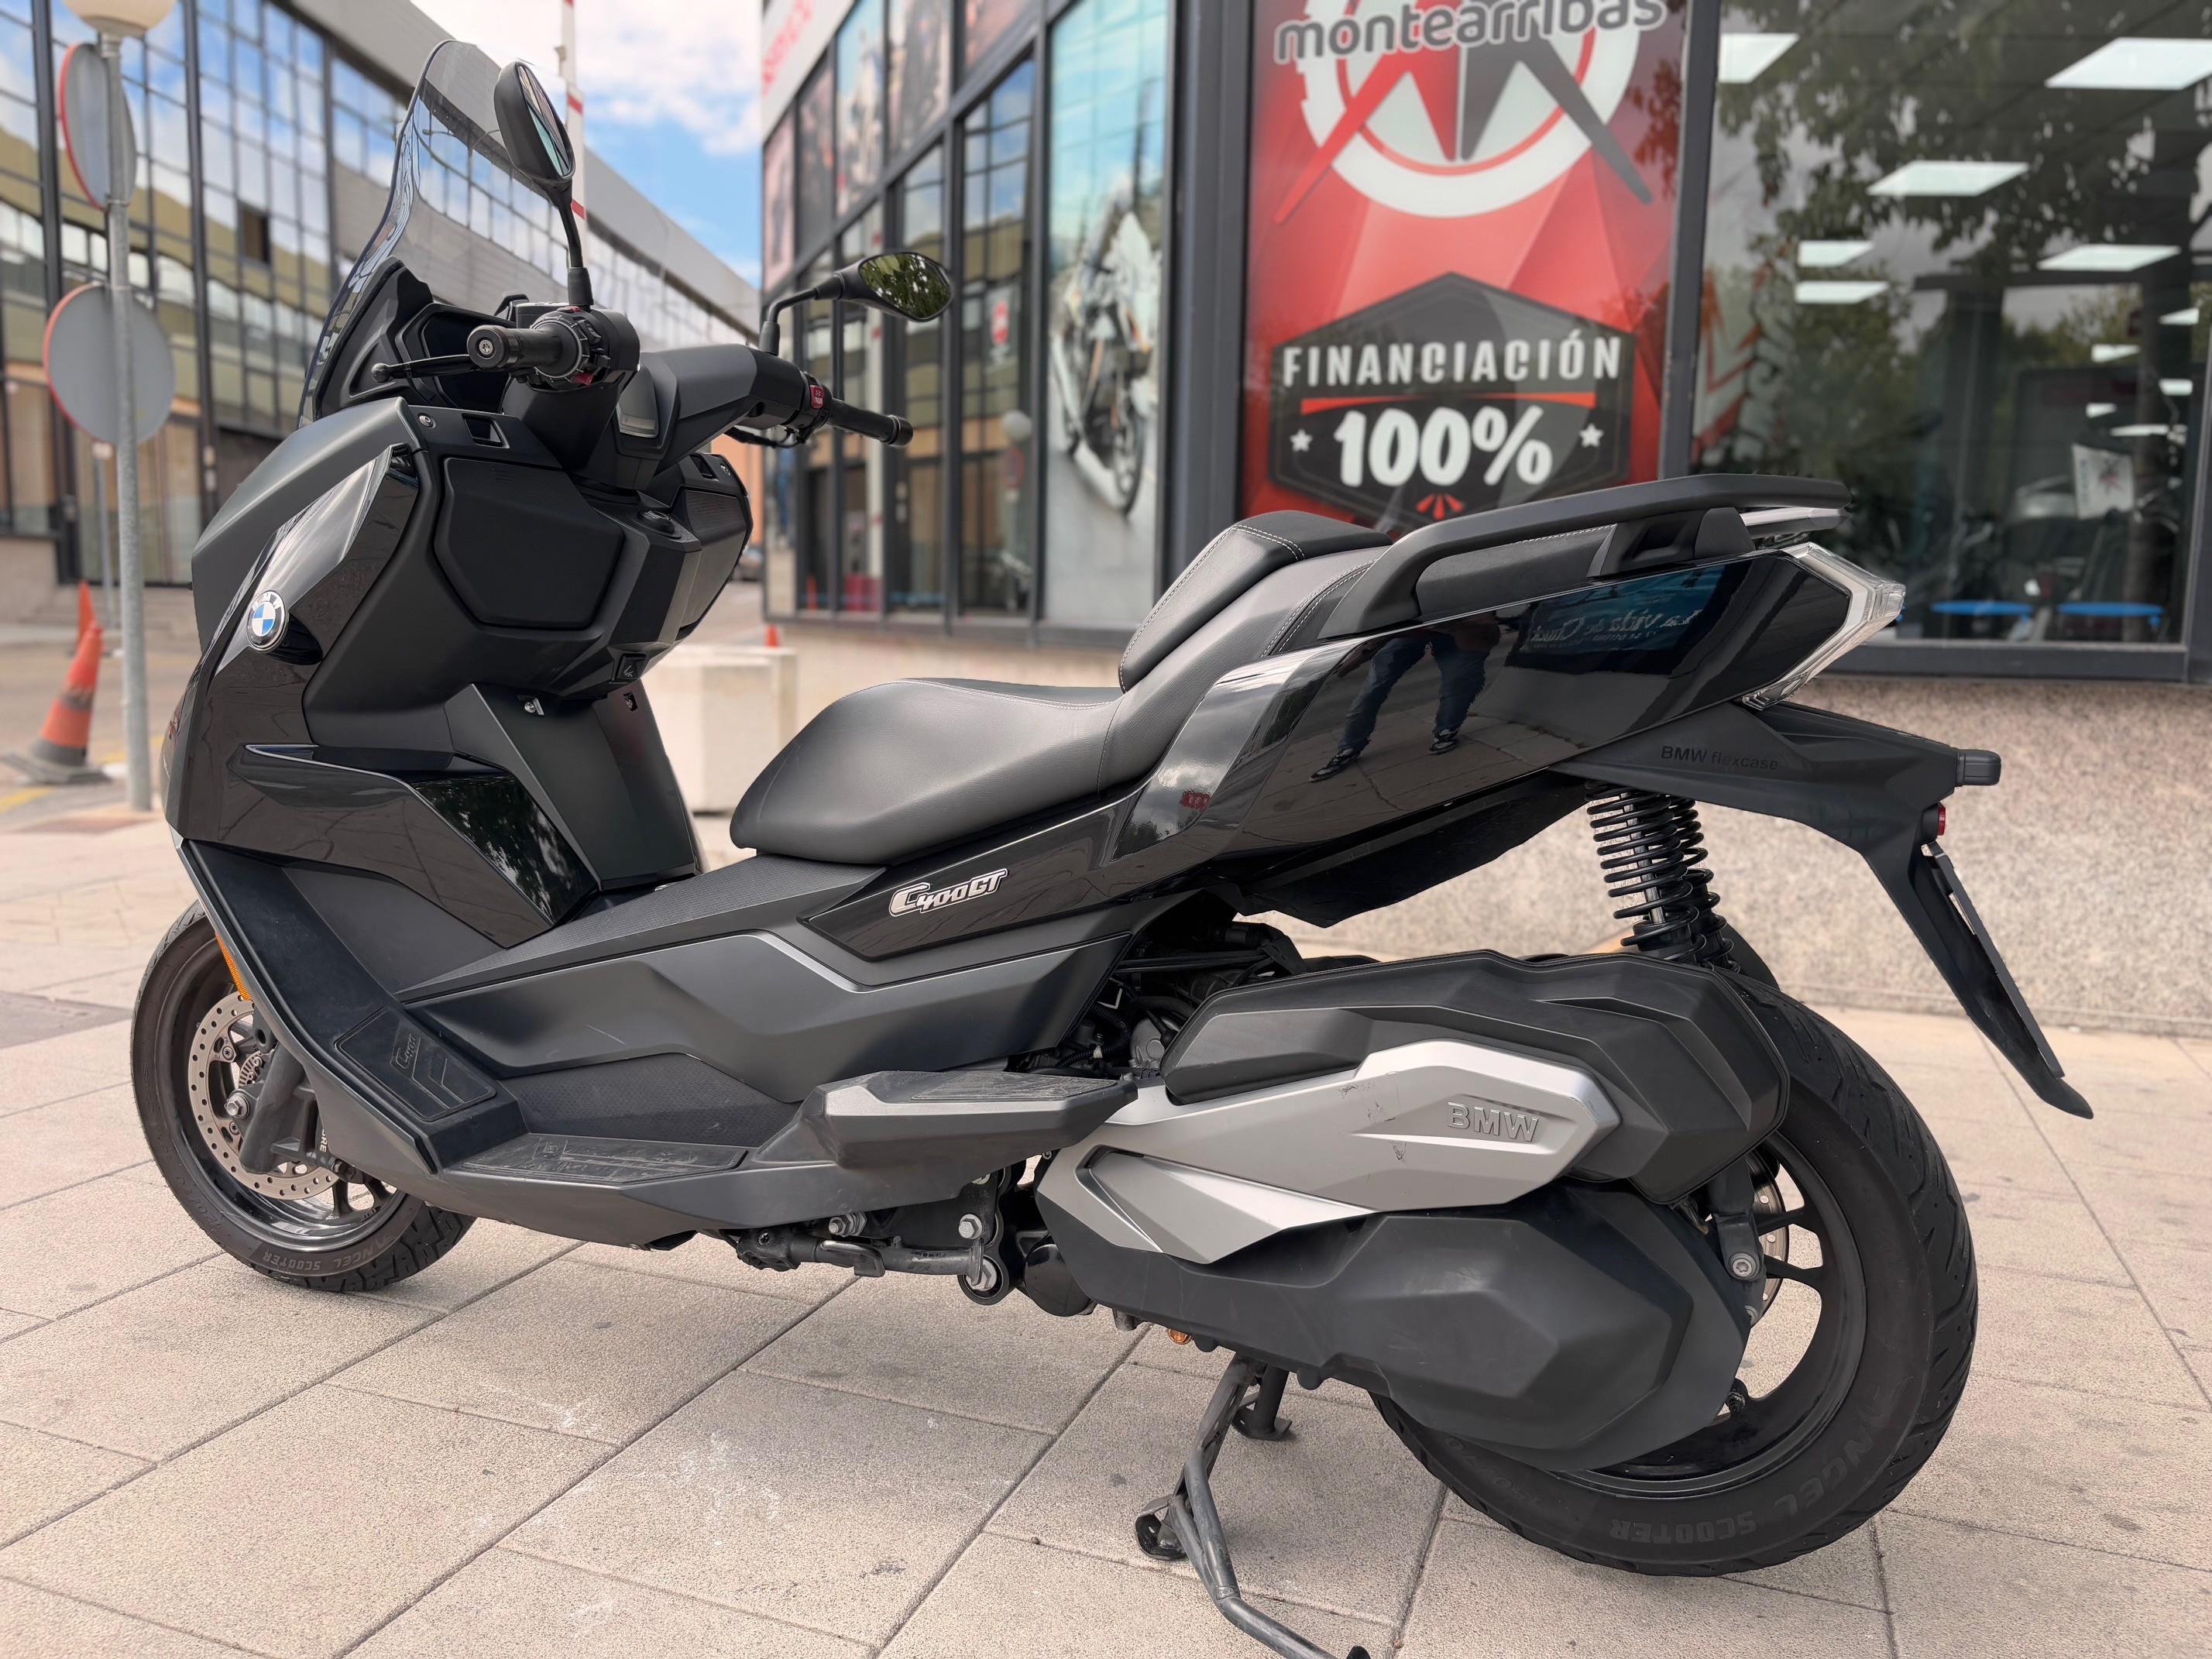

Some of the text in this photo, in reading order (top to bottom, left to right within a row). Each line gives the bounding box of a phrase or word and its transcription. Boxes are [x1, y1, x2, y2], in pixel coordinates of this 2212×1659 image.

[1276, 0, 1665, 62] montearribas
[1283, 328, 1621, 386] FINANCIACIÓN
[1334, 405, 1553, 487] 100%
[1661, 744, 1779, 771] BMW flexcase
[1446, 1101, 1540, 1142] BMW
[262, 1252, 322, 1272] SCOOTER
[1609, 1510, 1757, 1545] SCOOTER
